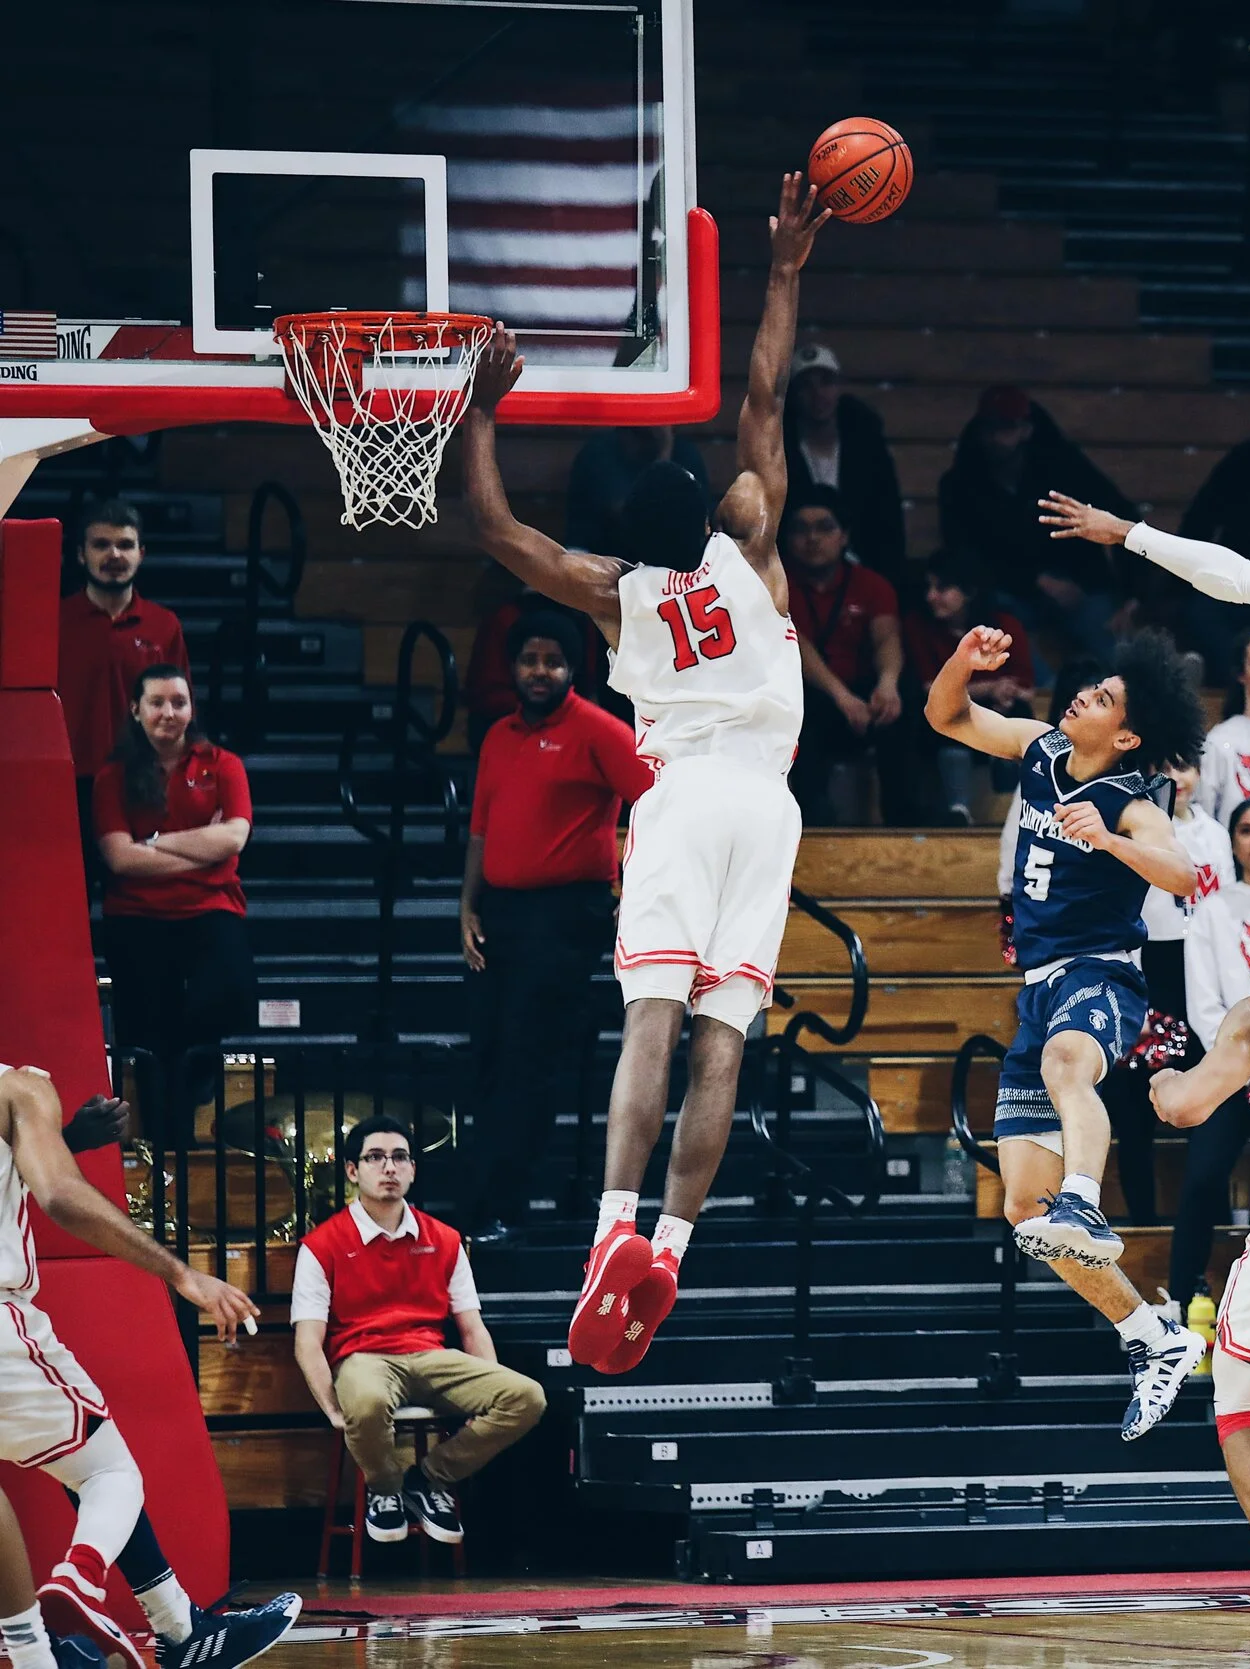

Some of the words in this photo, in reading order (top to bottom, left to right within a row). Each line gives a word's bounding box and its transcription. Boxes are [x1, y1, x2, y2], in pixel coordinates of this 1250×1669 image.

[850, 166, 880, 197] THE
[657, 584, 737, 672] 15
[1023, 844, 1055, 902] 5
